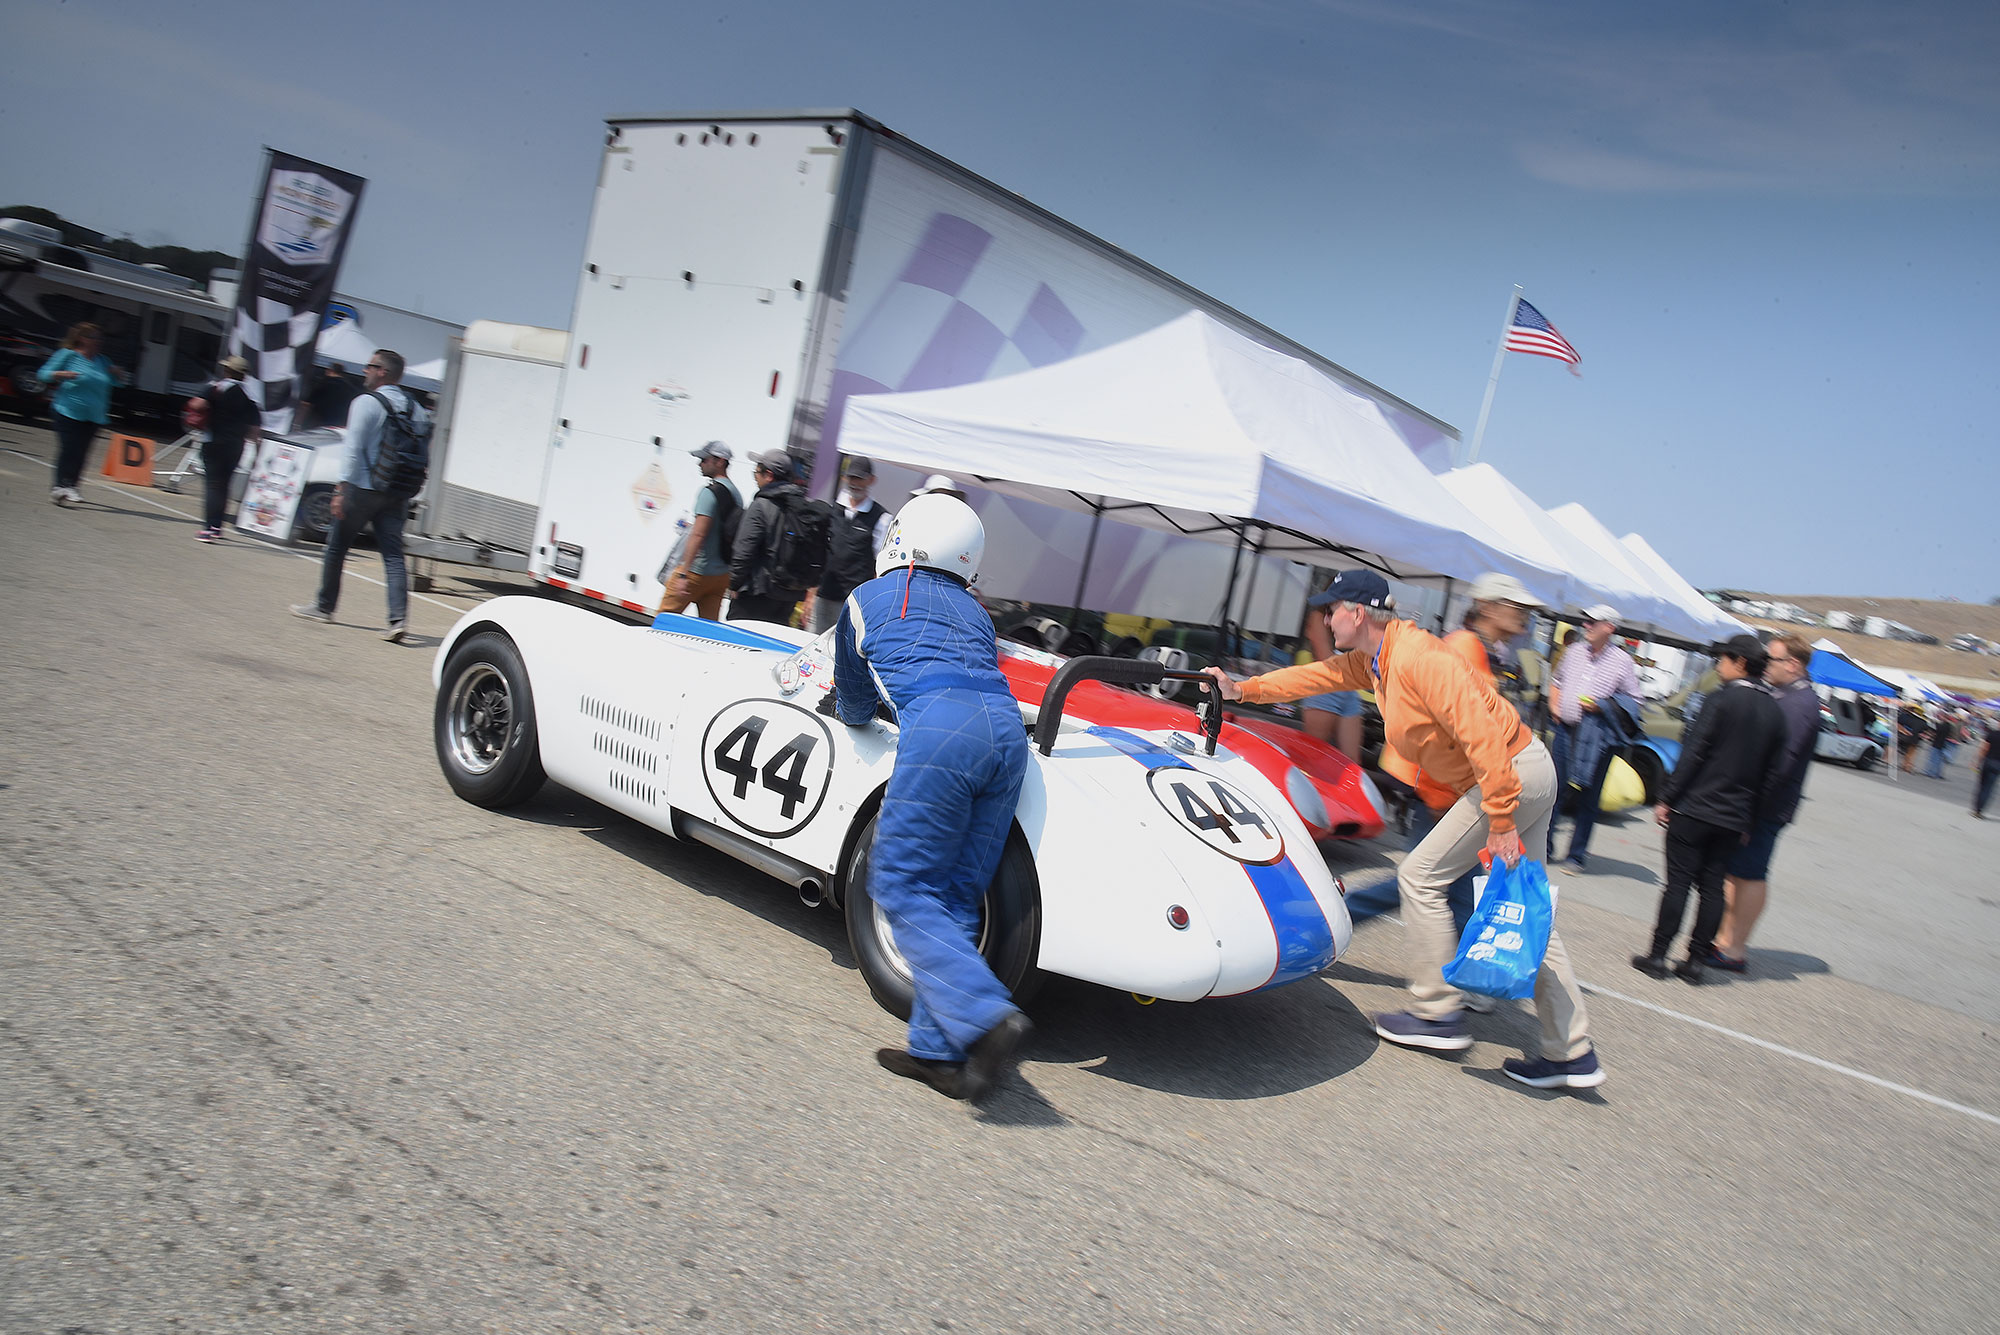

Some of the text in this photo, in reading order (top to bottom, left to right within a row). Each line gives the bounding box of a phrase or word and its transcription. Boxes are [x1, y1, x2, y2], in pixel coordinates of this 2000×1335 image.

[123, 439, 145, 467] D
[714, 715, 819, 820] 44
[1170, 781, 1274, 844] 44
